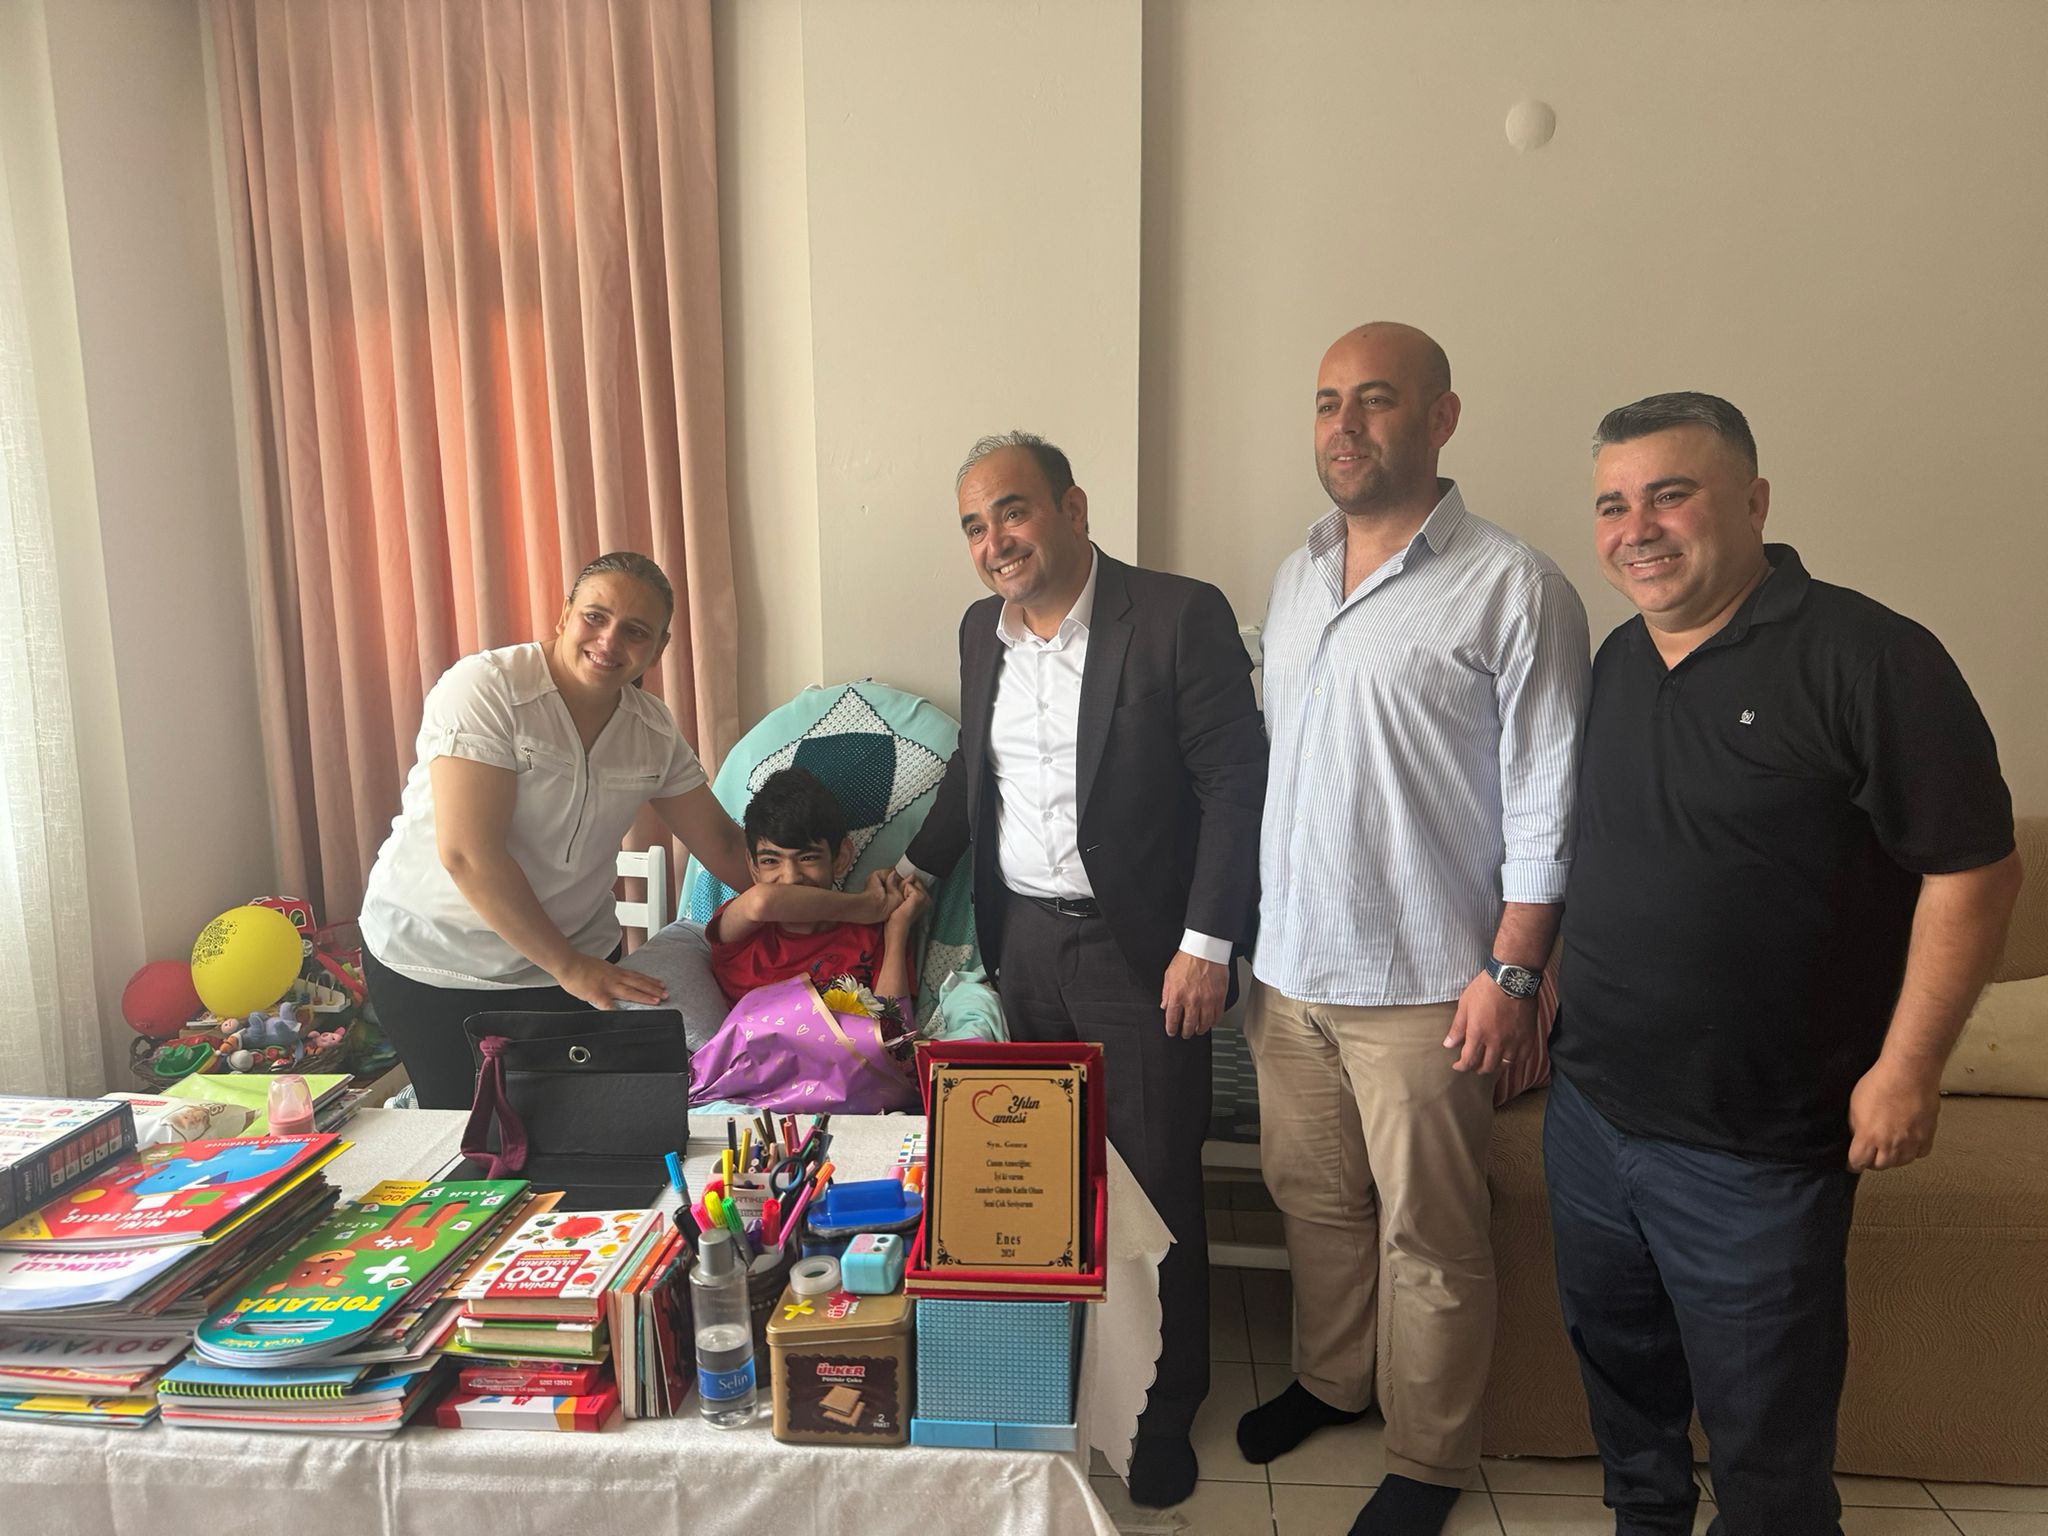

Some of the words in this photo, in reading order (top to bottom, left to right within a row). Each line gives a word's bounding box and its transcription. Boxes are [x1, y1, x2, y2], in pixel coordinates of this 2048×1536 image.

[1008, 1095, 1040, 1114] Yılın
[992, 1111, 1028, 1124] annesi
[996, 1232, 1021, 1246] Enes
[515, 1259, 579, 1268] BİLGİLERİM
[504, 1266, 572, 1282] 100
[497, 1281, 518, 1292] İLK
[519, 1281, 560, 1292] BENİM
[233, 1296, 385, 1313] TOPLAMA
[816, 1362, 866, 1378] ÜLKER
[719, 1374, 748, 1391] Selin
[878, 1413, 886, 1422] 2
